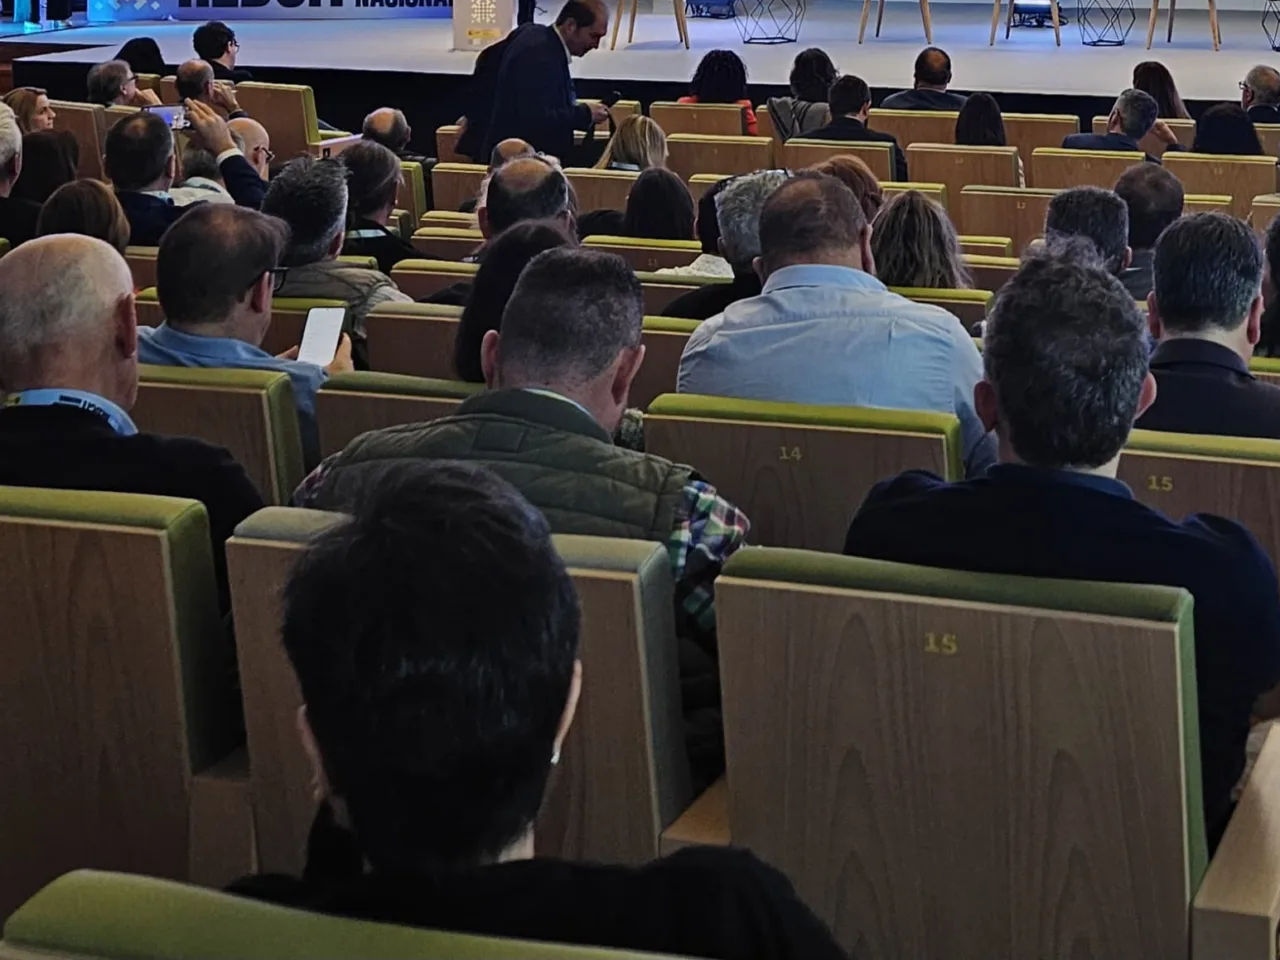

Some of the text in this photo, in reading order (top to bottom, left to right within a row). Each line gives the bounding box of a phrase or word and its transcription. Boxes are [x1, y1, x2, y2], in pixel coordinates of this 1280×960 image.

[779, 446, 802, 461] 14
[1148, 475, 1174, 491] 15
[924, 632, 957, 655] 15
